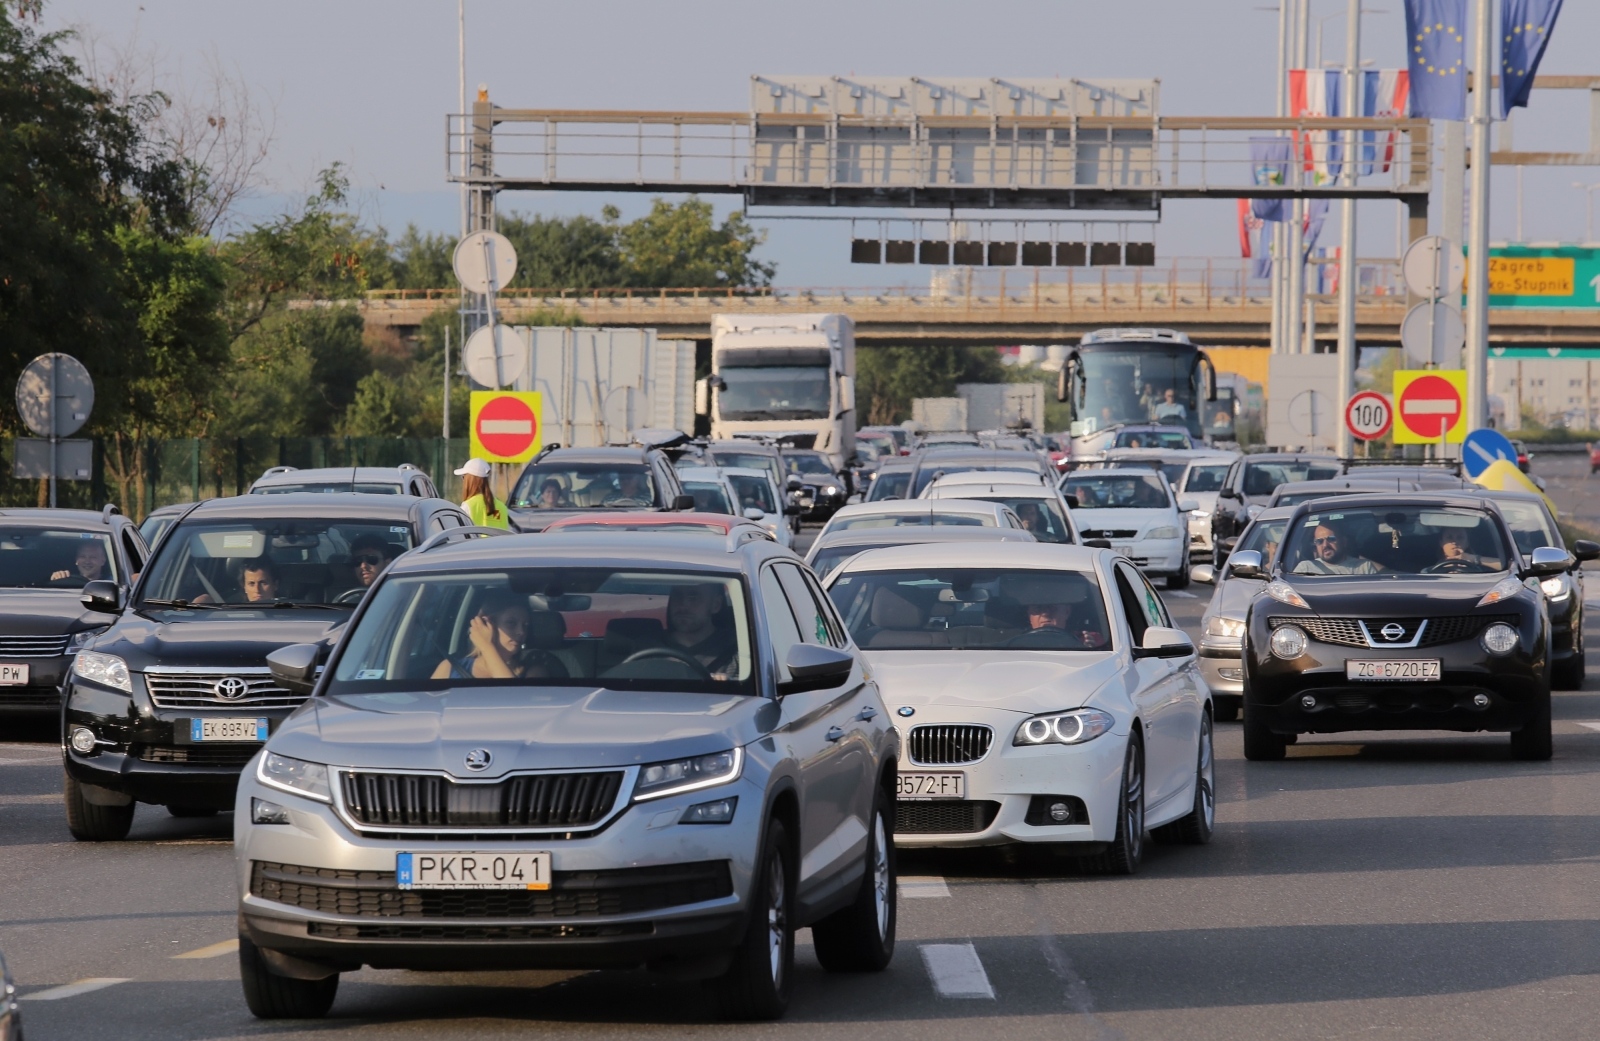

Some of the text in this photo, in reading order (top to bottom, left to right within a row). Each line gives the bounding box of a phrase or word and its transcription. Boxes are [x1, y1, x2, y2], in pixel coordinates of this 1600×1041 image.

[1489, 260, 1545, 275] Zagreb
[1462, 277, 1569, 293] Lko-Stupnik
[1354, 405, 1383, 427] 100
[1358, 662, 1375, 677] ZG
[401, 870, 410, 880] H
[419, 856, 540, 881] PKR-041
